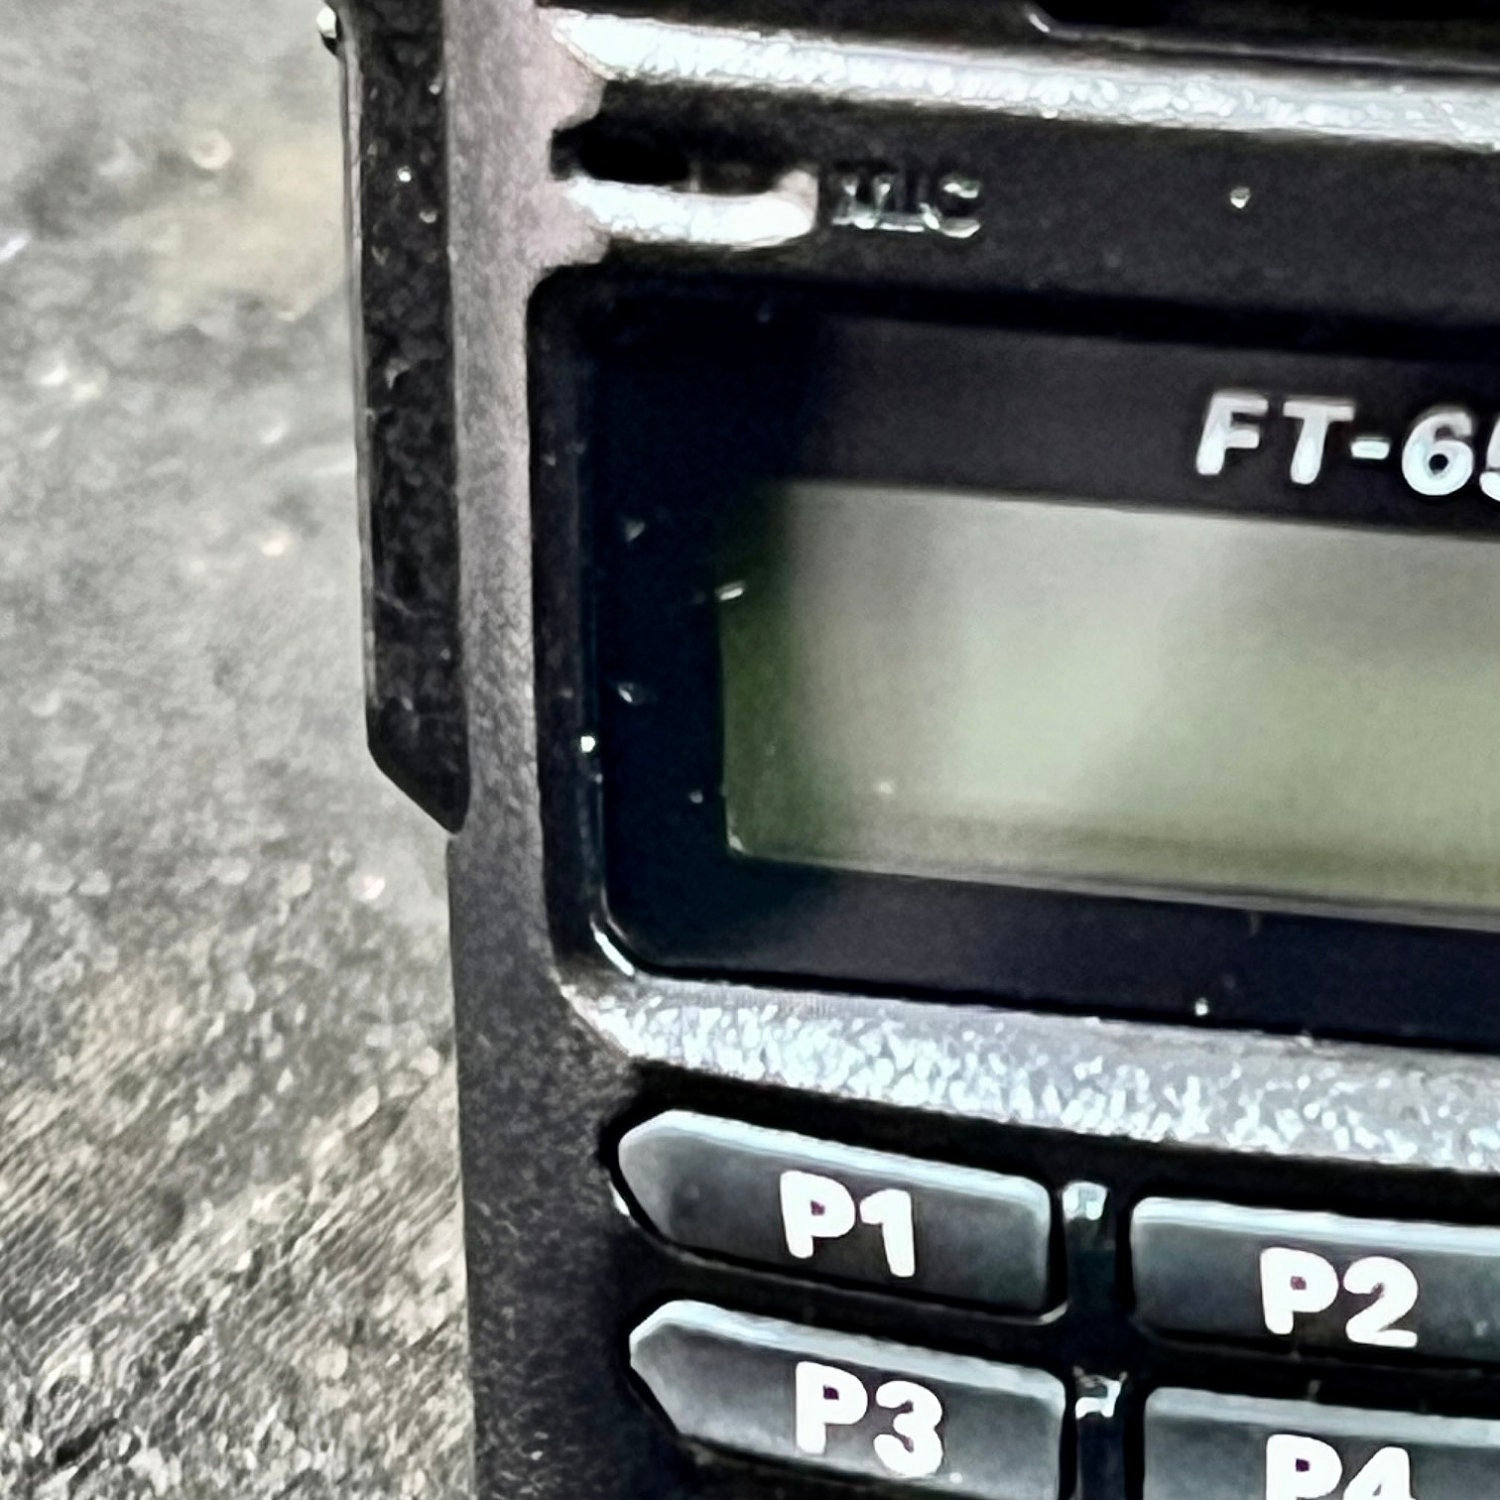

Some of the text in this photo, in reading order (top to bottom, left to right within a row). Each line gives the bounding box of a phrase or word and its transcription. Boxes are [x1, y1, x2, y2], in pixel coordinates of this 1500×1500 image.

[779, 1169, 916, 1278] P1
[1259, 1246, 1419, 1349] P2
[792, 1360, 945, 1480] P3
